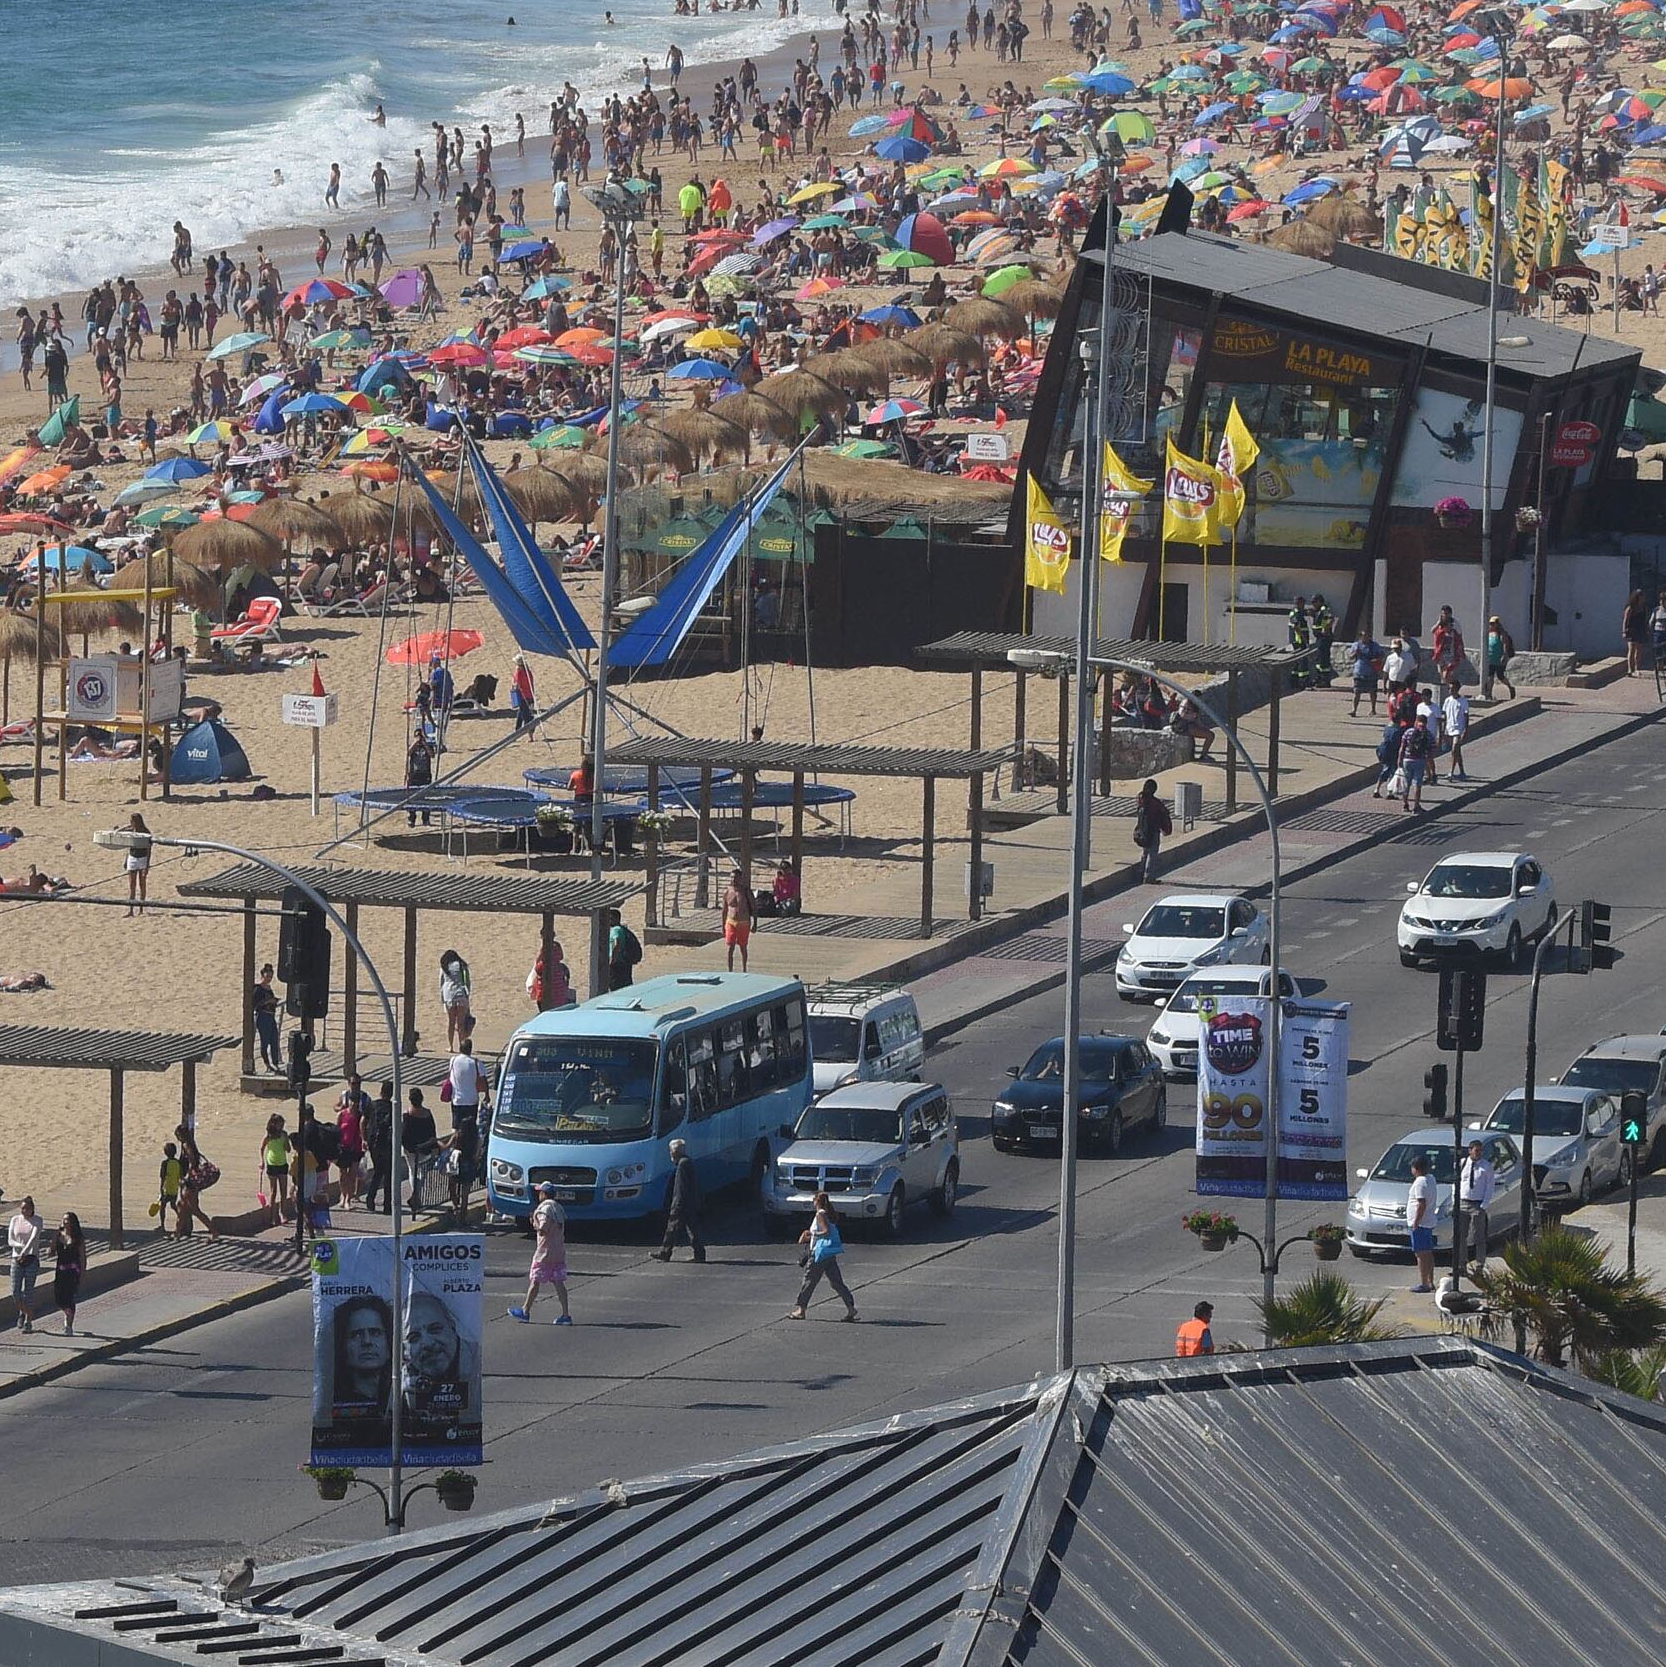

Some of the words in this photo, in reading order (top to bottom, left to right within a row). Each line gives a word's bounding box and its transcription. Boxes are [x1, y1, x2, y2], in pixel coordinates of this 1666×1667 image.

[1215, 335, 1276, 351] CRISTAL
[1289, 340, 1310, 361] LA
[1316, 347, 1371, 376] PLAYA
[83, 680, 101, 699] 137
[1213, 1028, 1253, 1043] TIME
[1208, 1045, 1223, 1058] to
[1227, 1044, 1261, 1059] WIN
[1301, 1036, 1320, 1060] 5
[1209, 1079, 1256, 1087] HASTA
[1299, 1088, 1320, 1114] 5
[1202, 1092, 1263, 1128] 90
[404, 1245, 482, 1260] AMIGOS
[412, 1263, 469, 1272] COMPLICES
[320, 1285, 374, 1296] HERRERA
[443, 1284, 481, 1293] PLAZA
[441, 1384, 454, 1392] 27
